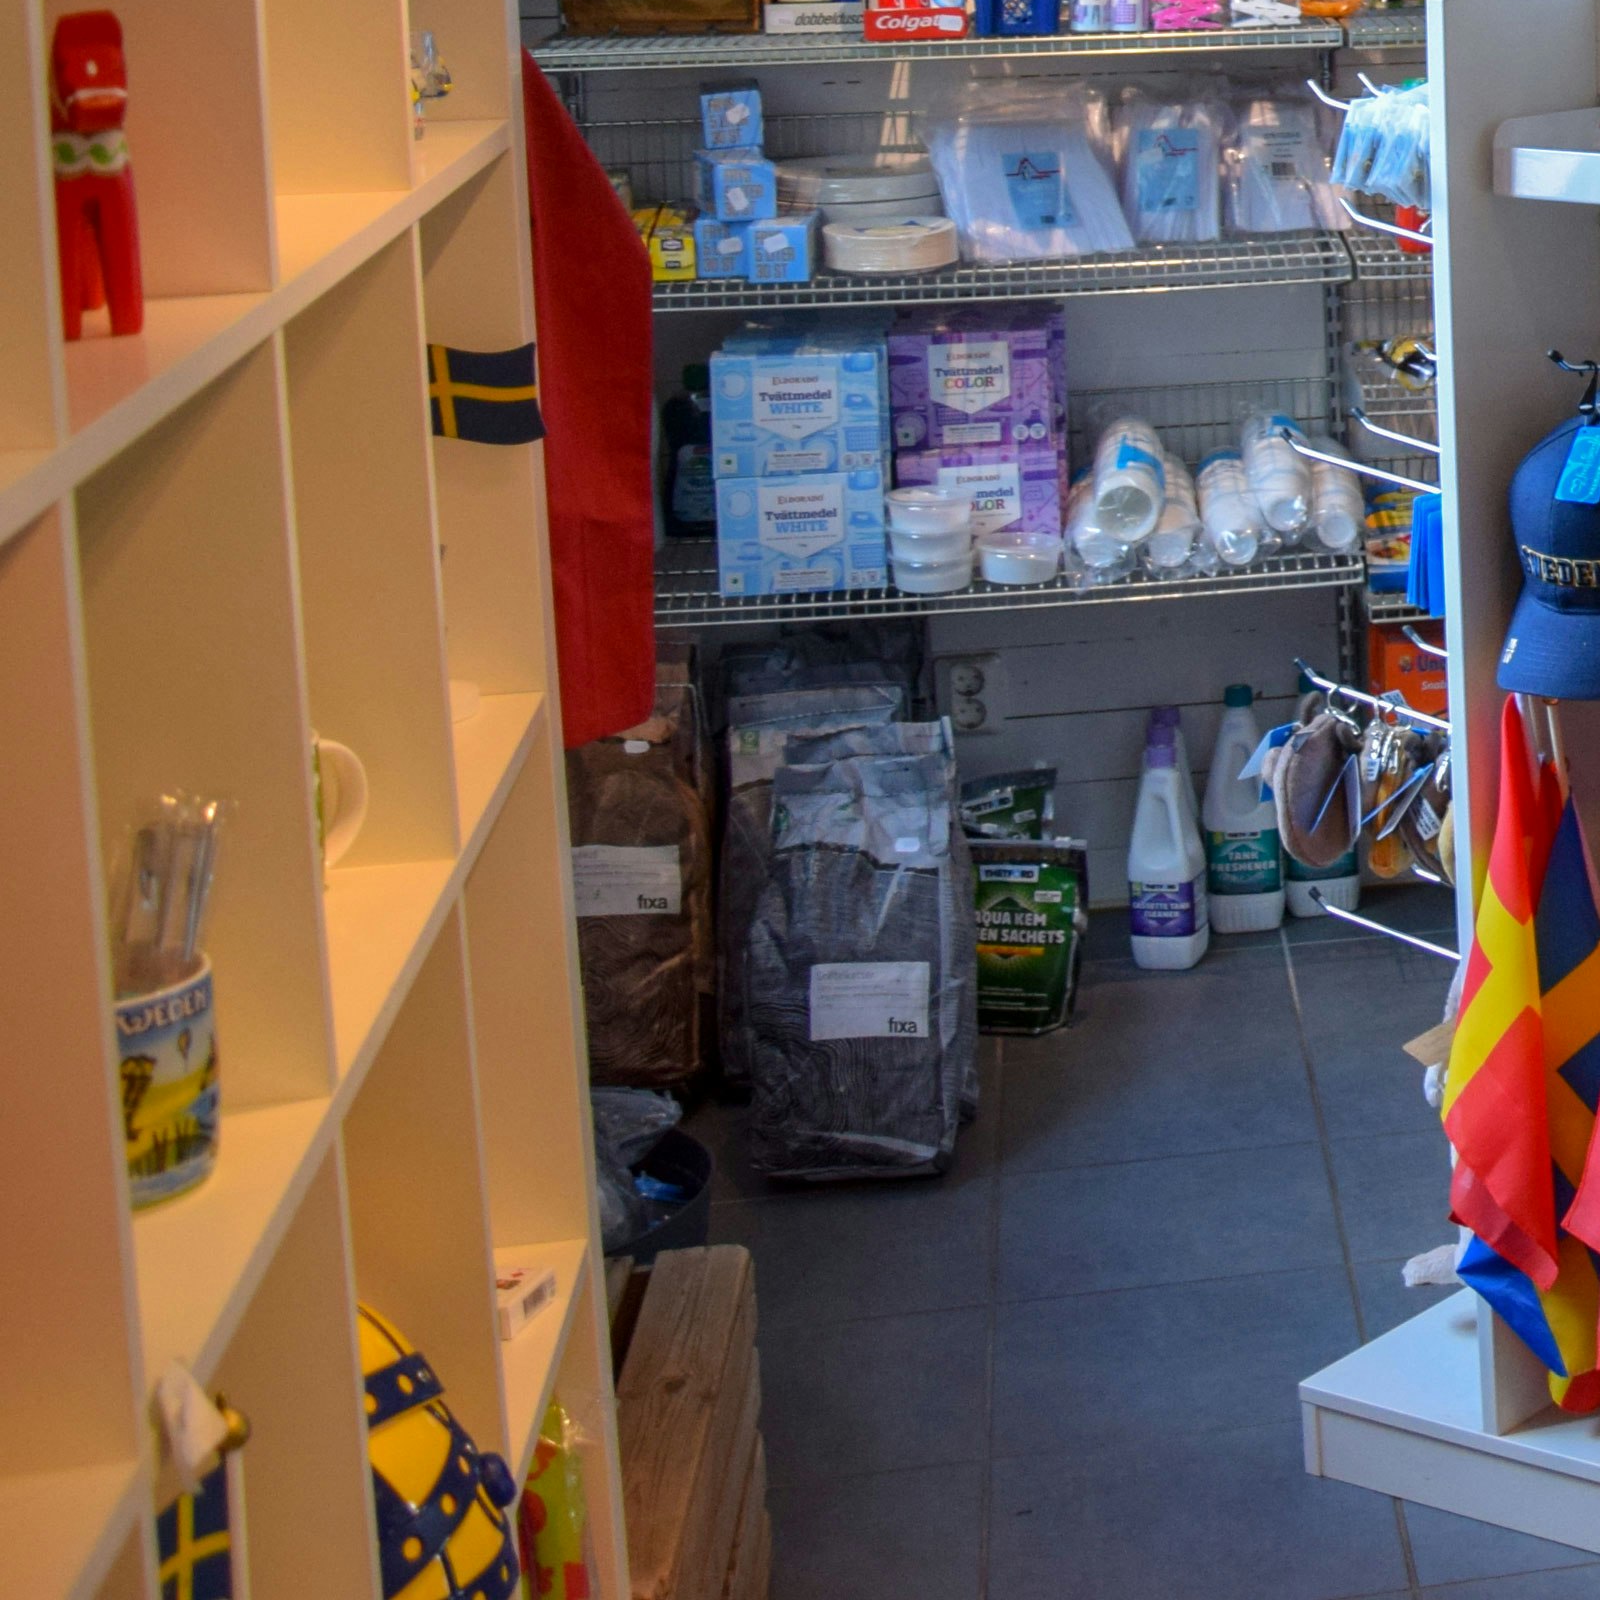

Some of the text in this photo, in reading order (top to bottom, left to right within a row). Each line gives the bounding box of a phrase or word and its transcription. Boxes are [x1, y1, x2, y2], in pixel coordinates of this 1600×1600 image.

[876, 12, 941, 31] Colgat
[935, 365, 1004, 378] Tvättmedel
[944, 376, 995, 389] COLOR
[759, 390, 832, 402] Tvättmedel
[769, 402, 823, 415] WHITE
[765, 508, 837, 521] Tvättmedel
[775, 520, 828, 533] WHITE
[1228, 852, 1258, 861] TANK
[1211, 861, 1277, 872] FRESHENER
[637, 894, 667, 910] fixa
[1014, 911, 1047, 927] KEM
[1001, 929, 1065, 944] SACHETS
[117, 987, 207, 1036] WEDEN
[888, 1017, 917, 1034] fixa
